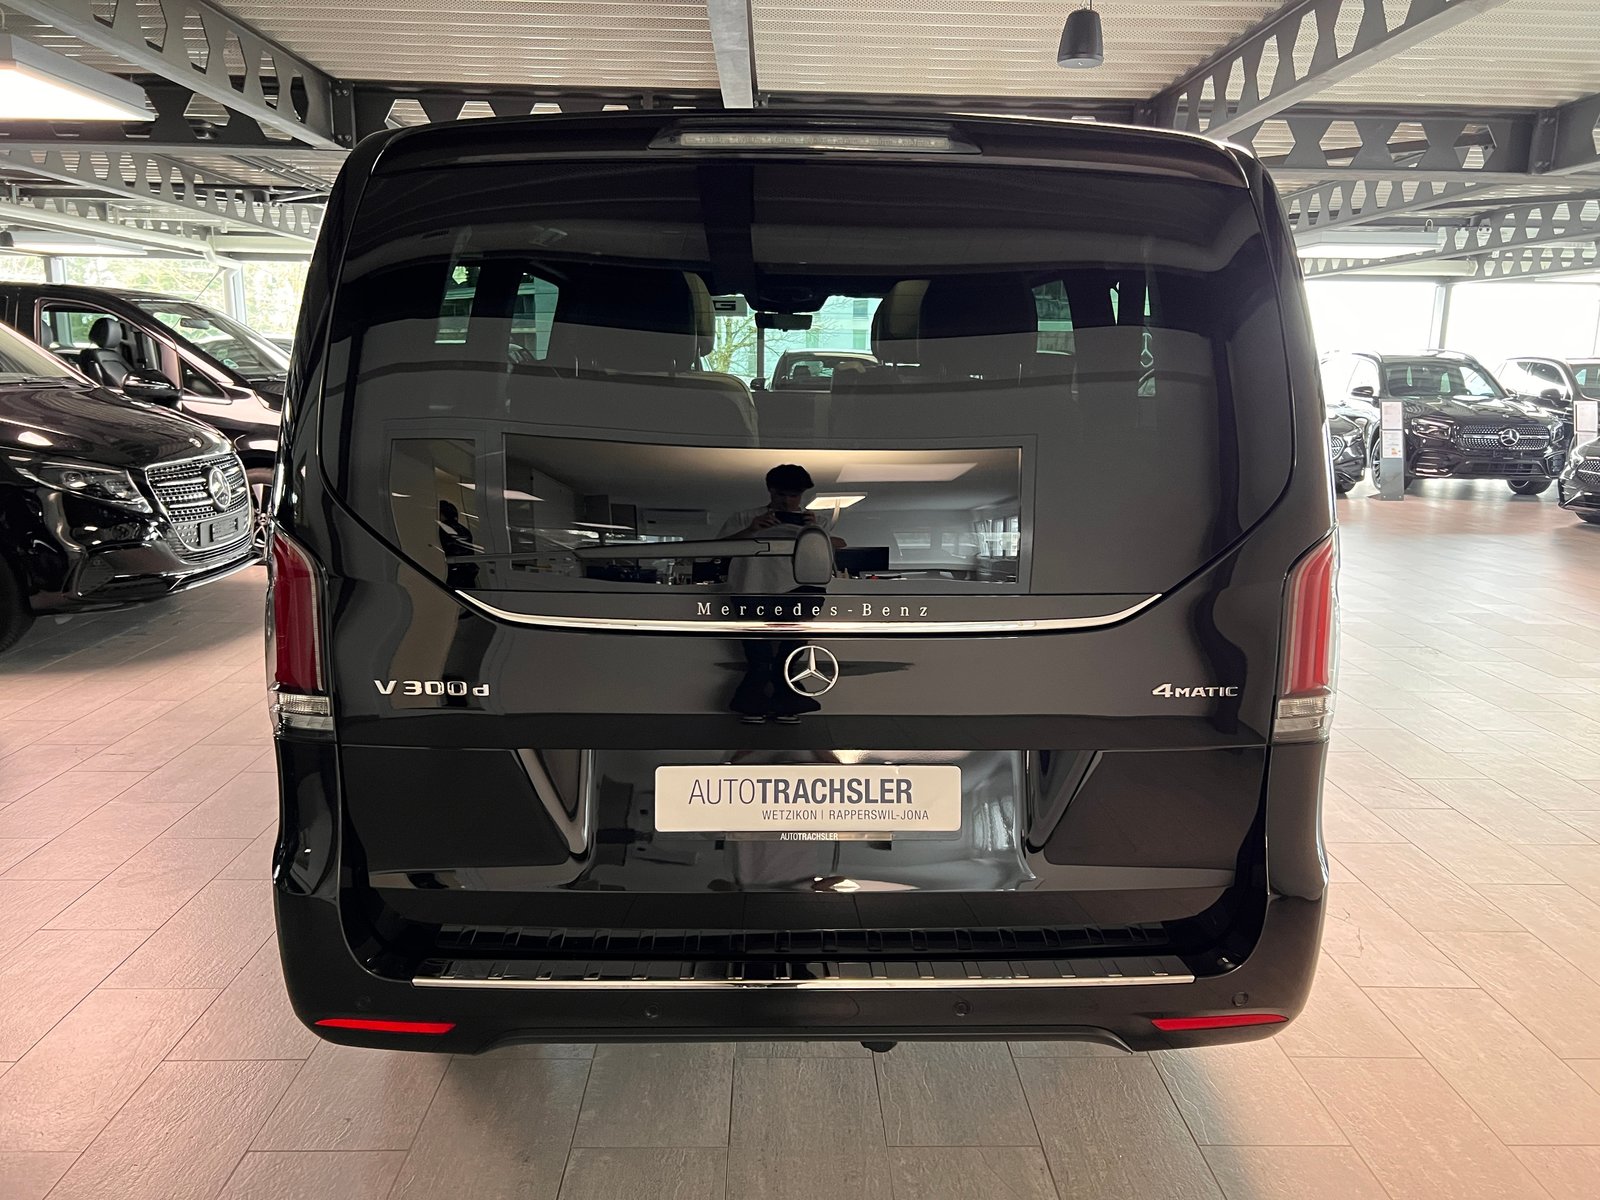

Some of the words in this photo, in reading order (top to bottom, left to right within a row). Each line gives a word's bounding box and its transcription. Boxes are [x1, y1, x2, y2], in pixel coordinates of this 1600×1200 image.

[697, 602, 928, 617] Mercedes-Benz
[373, 680, 397, 695] V
[403, 680, 468, 696] 300
[472, 684, 490, 696] d
[1152, 683, 1239, 698] 4MATIC
[688, 778, 913, 804] AUTOTRACHSLER
[762, 810, 817, 820] WETZIKON
[829, 810, 929, 820] RAPPERSWIL-JONA
[780, 832, 838, 841] AUTOTRACHSLER
